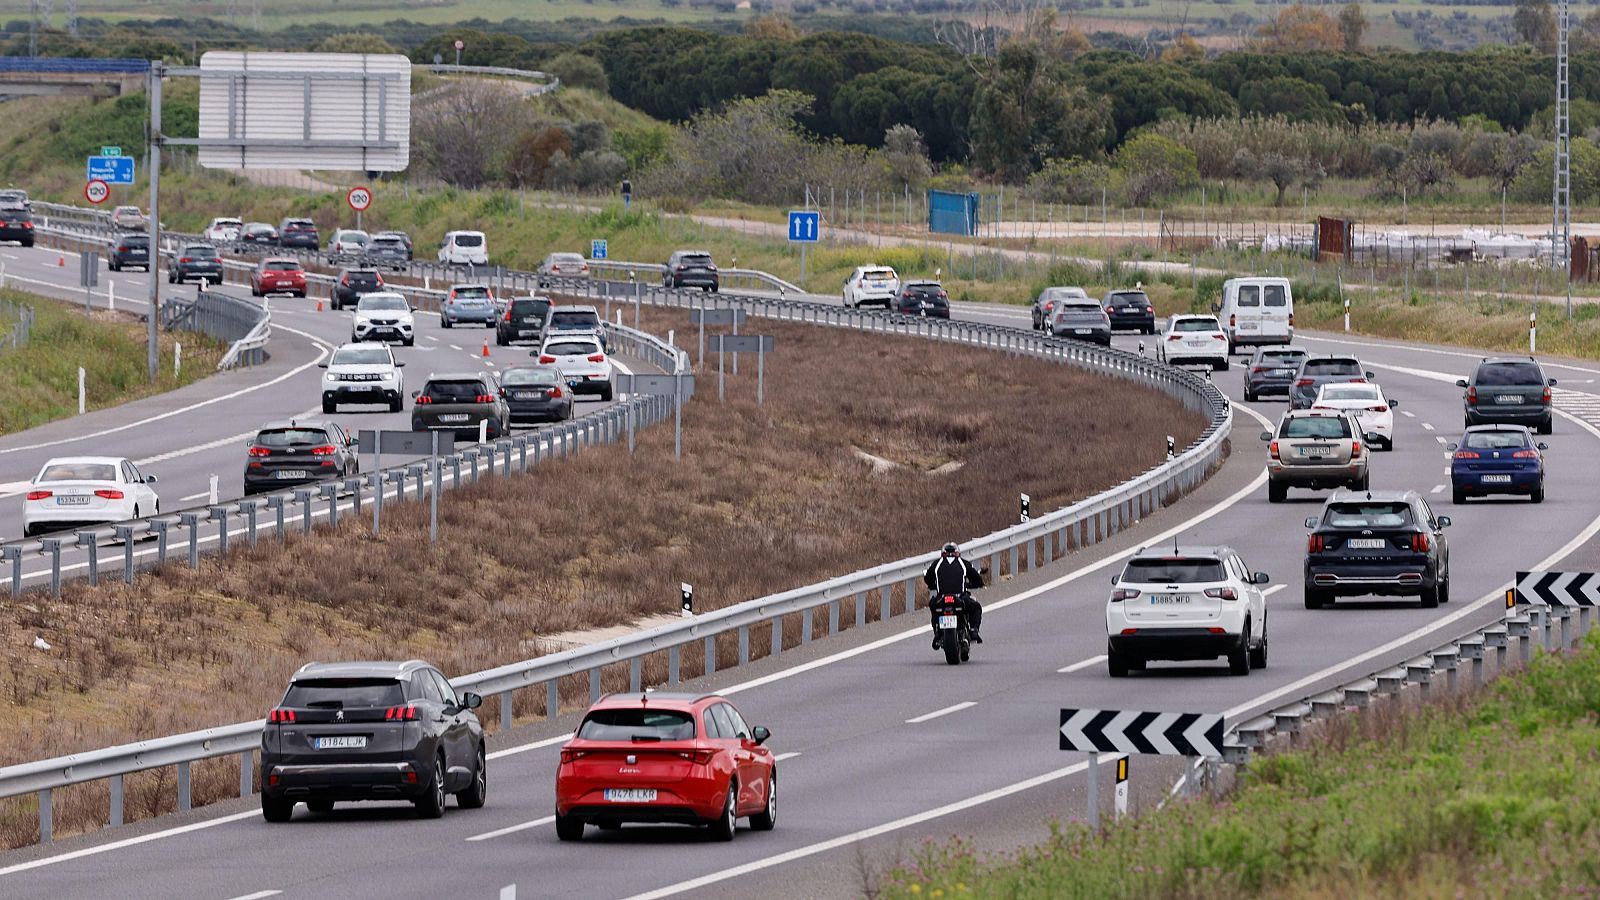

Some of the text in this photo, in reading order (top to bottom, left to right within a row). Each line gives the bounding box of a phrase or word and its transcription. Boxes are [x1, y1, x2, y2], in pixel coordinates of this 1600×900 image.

[90, 187, 105, 196] 120
[352, 194, 367, 203] 120
[1156, 595, 1173, 604] 5885
[322, 736, 363, 746] 3184 LJK
[611, 789, 655, 799] 9476 LKR
